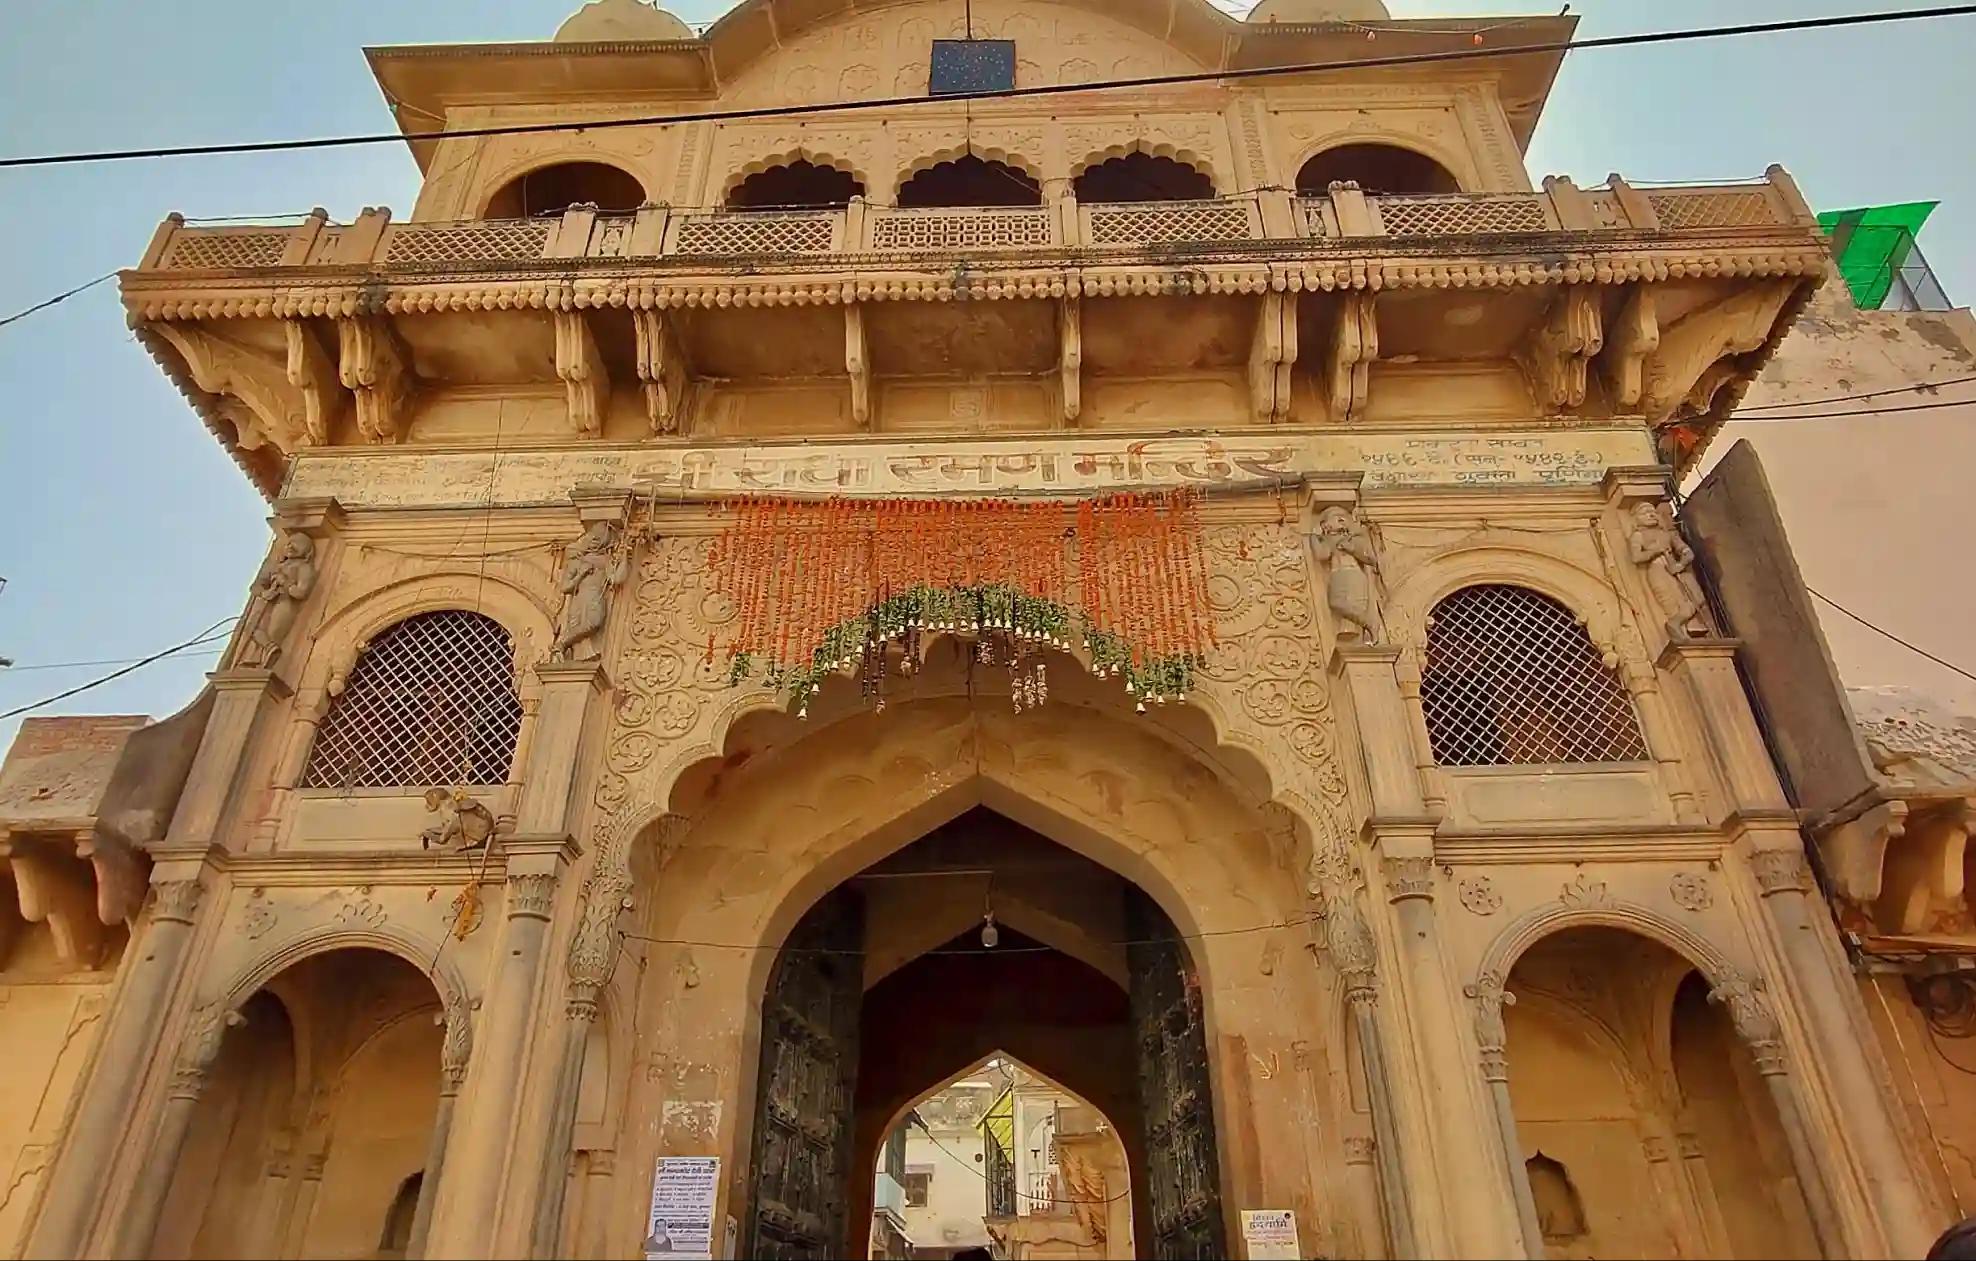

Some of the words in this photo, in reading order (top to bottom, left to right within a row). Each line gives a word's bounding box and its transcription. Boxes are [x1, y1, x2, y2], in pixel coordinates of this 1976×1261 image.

[631, 450, 718, 489] श्री
[735, 453, 872, 486] राधा
[885, 450, 1063, 482] रमण
[1073, 439, 1296, 481] मन्दिर
